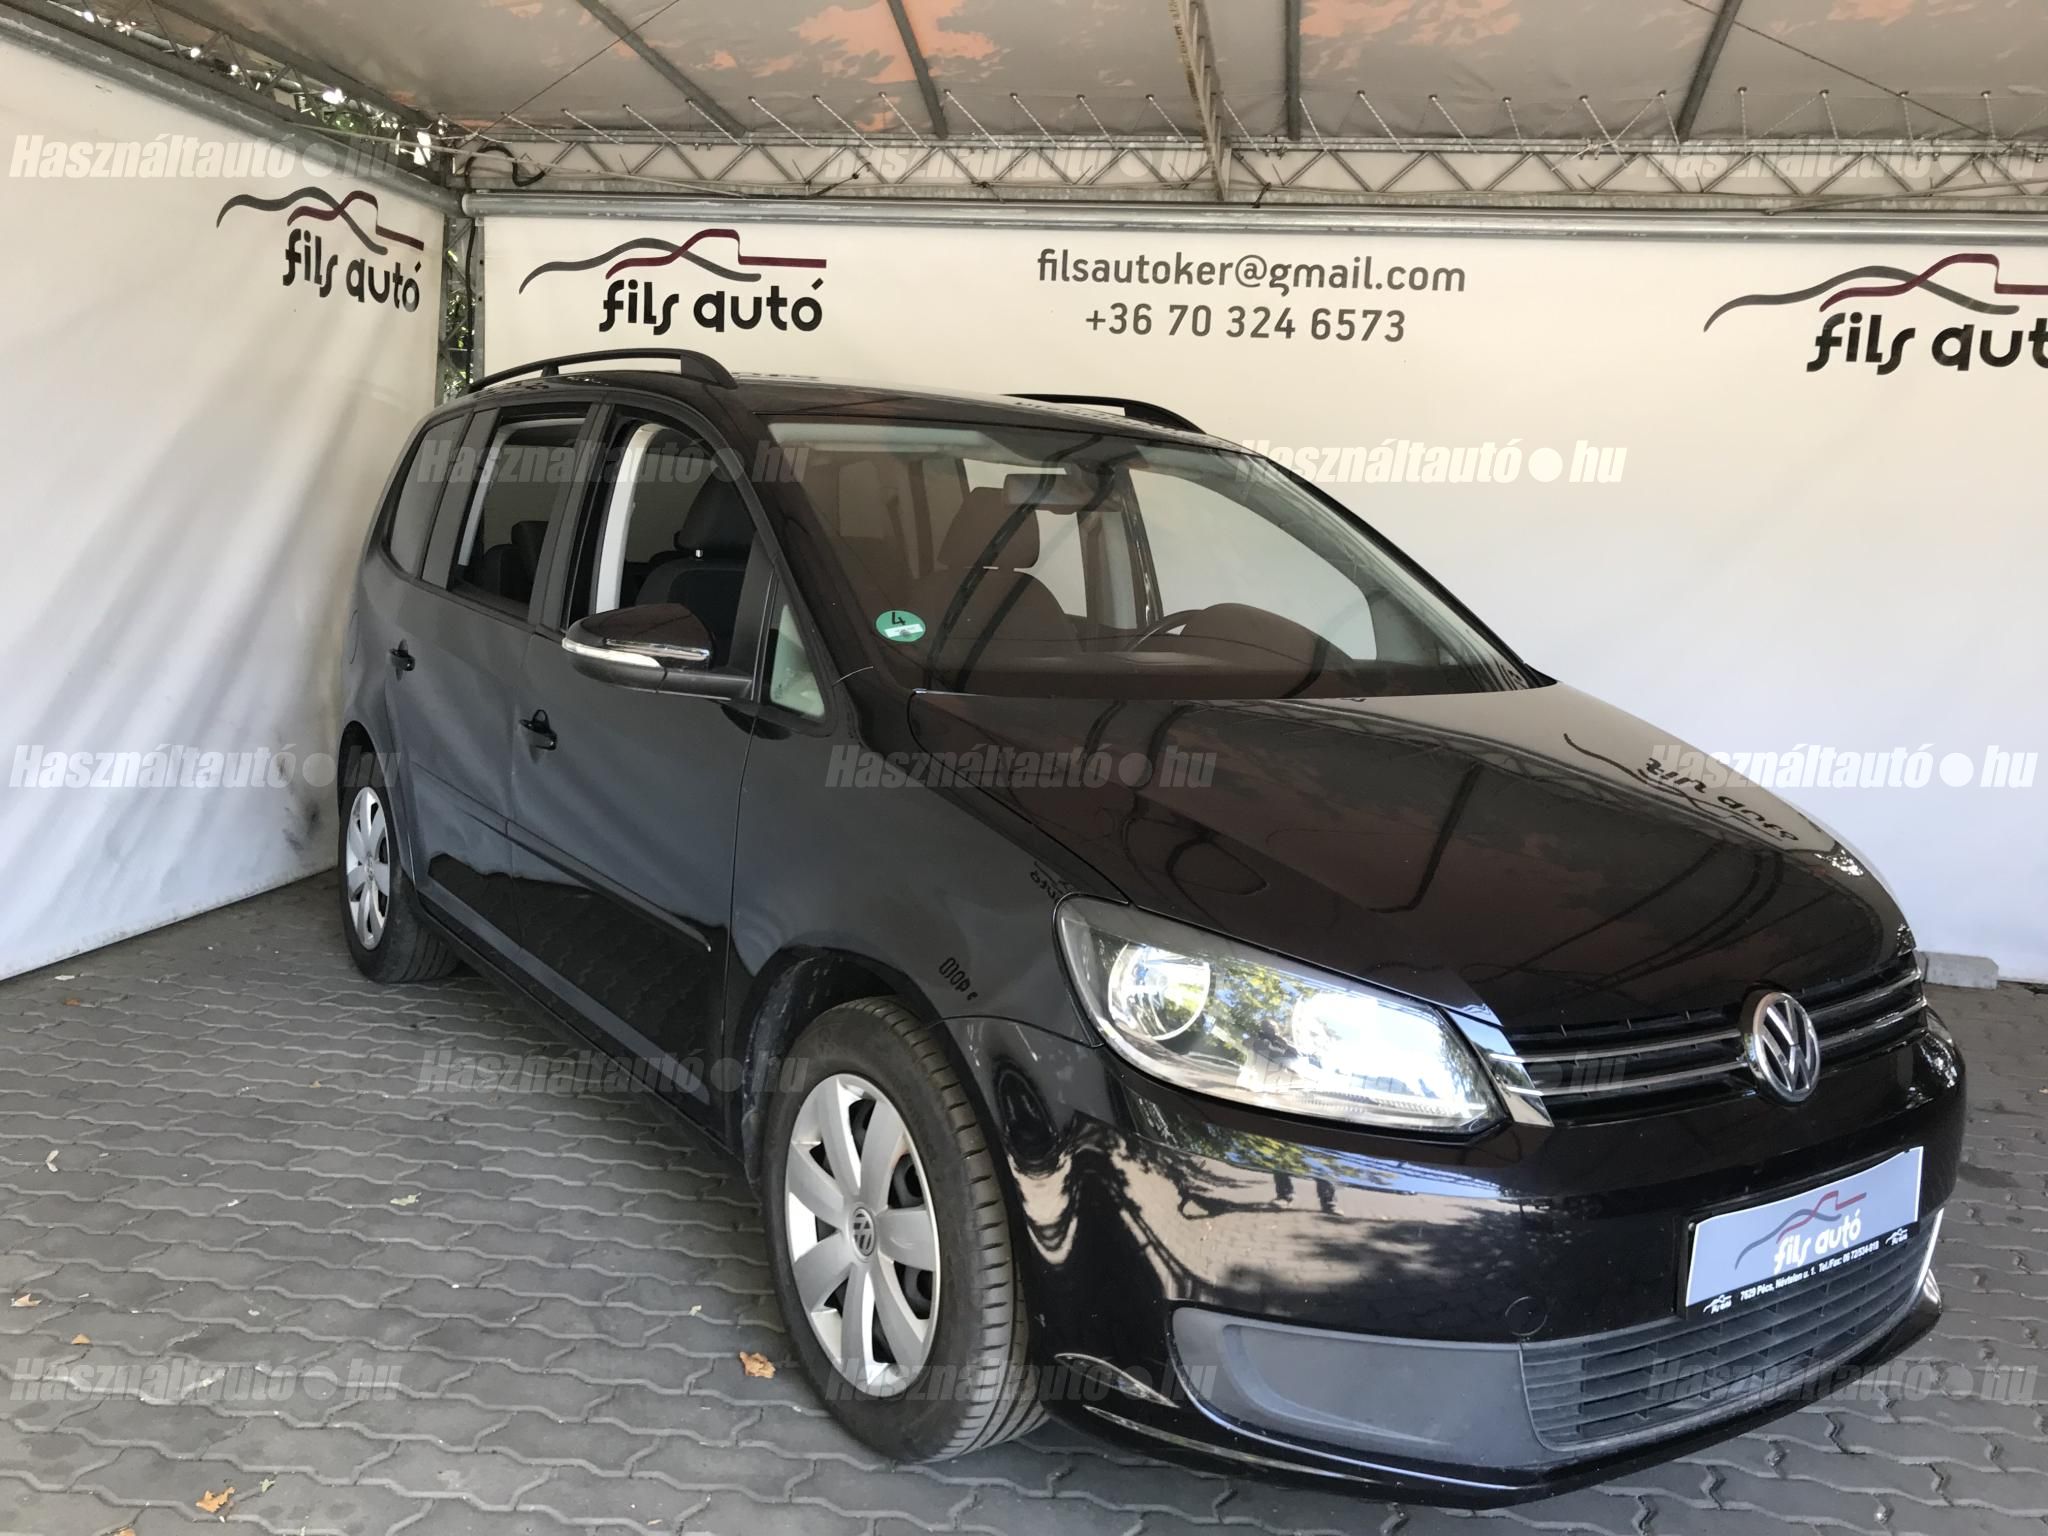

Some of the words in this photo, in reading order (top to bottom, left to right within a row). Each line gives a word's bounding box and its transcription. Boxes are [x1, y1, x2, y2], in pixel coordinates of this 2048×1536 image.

[282, 228, 340, 300] fils
[1037, 248, 1467, 297] filsautoker@gmail.com
[599, 279, 680, 336] fils
[693, 278, 825, 333] autó
[1085, 302, 1153, 336] +36
[1168, 304, 1212, 337] 70
[1225, 305, 1296, 339] 324
[1310, 307, 1405, 343] 6573
[1806, 311, 1916, 376] fils
